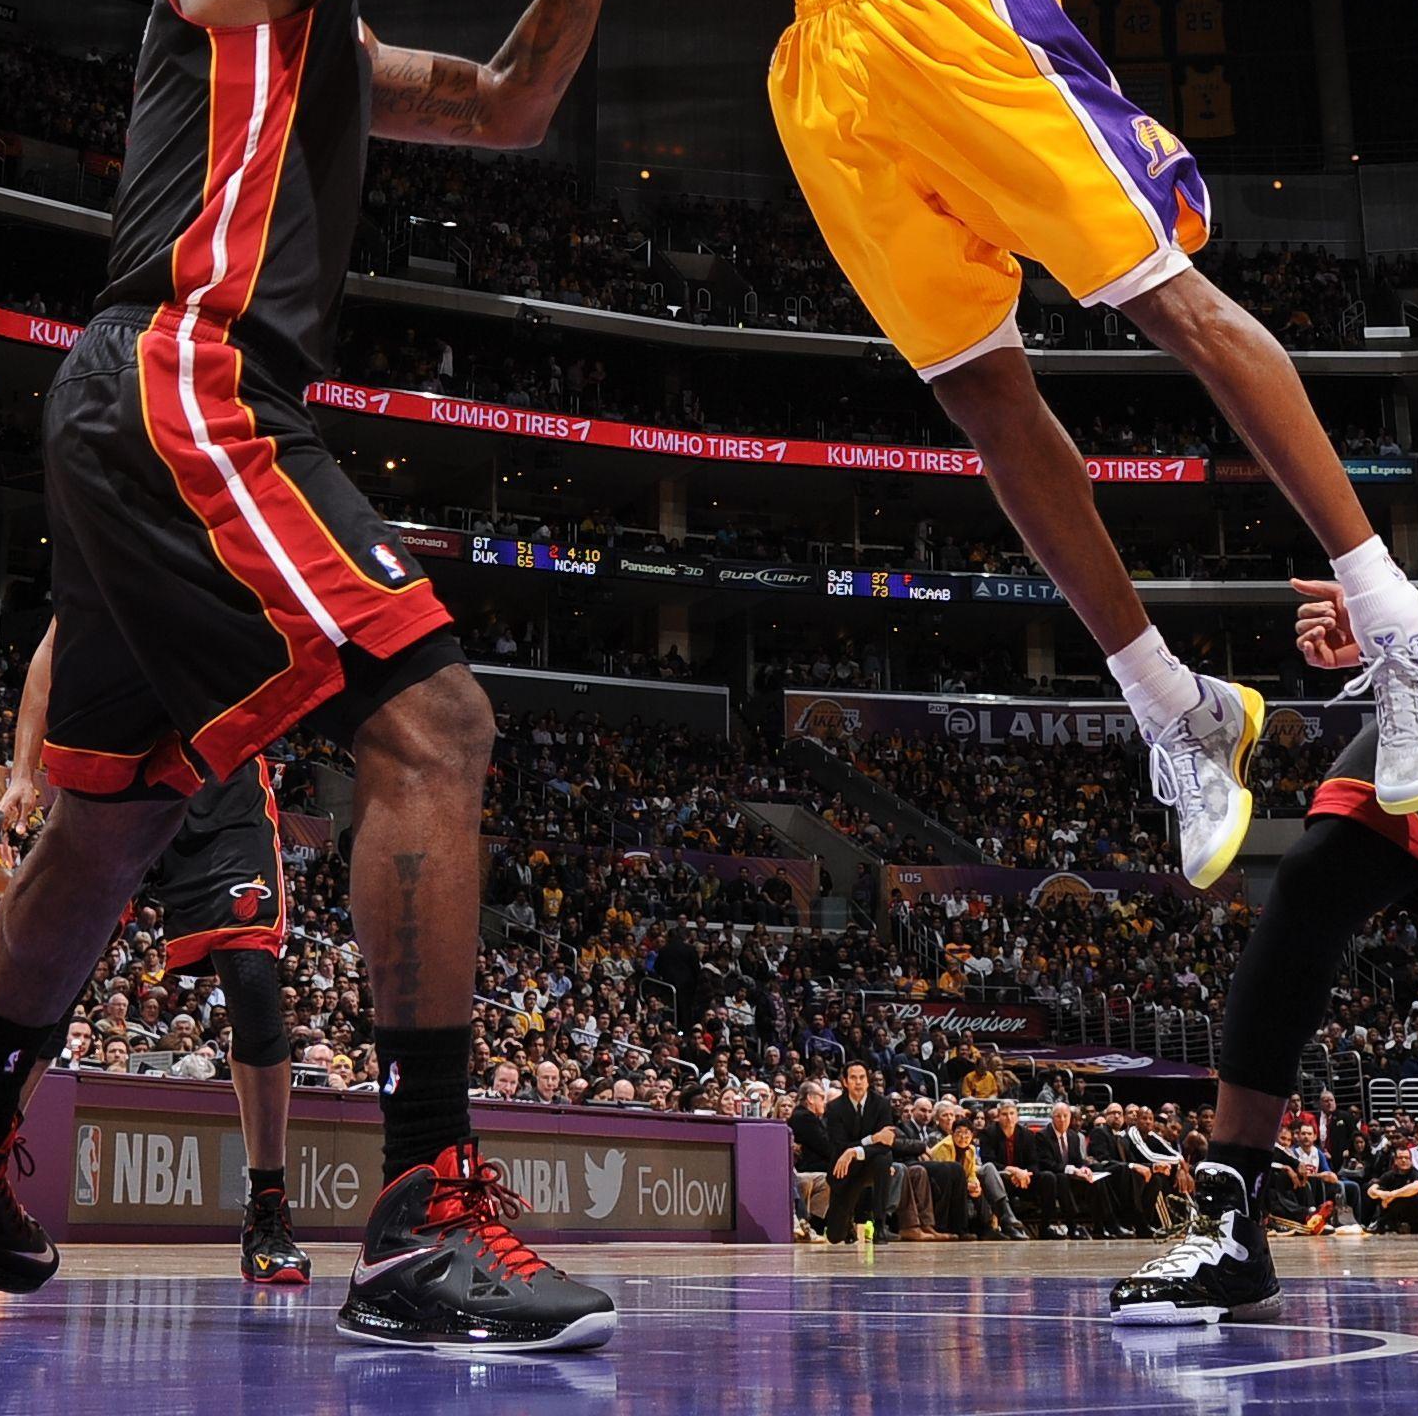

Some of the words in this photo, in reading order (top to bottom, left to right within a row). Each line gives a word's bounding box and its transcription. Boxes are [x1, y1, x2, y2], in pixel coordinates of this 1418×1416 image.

[30, 319, 84, 349] KUM
[314, 381, 367, 409] TIRES
[431, 400, 509, 429] KUMHO
[512, 413, 569, 438] TIRES
[630, 428, 705, 454] KUMHO
[707, 437, 764, 460] TIRES
[827, 445, 905, 469] KUMHO
[908, 451, 964, 473] TIRES
[1105, 461, 1162, 480] TIRES
[1370, 465, 1413, 477] Express
[399, 534, 449, 549] cDonald's
[517, 541, 533, 555] 51
[567, 547, 601, 562] 4:10
[472, 550, 499, 565] DUK
[517, 555, 534, 569] 65
[554, 558, 596, 575] NCAAB
[620, 559, 677, 576] Panasonic
[719, 570, 755, 581] BUD
[762, 571, 812, 583] LIGHT
[827, 570, 854, 583] SJS
[871, 572, 888, 584] 37
[827, 583, 854, 596] DEN
[871, 584, 889, 597] 73
[909, 587, 951, 601] NCAAB
[997, 582, 1065, 600] DELTA
[898, 872, 922, 884] 105
[113, 1132, 203, 1206] NBA
[286, 1148, 360, 1210] Like
[638, 1167, 727, 1216] Follow
